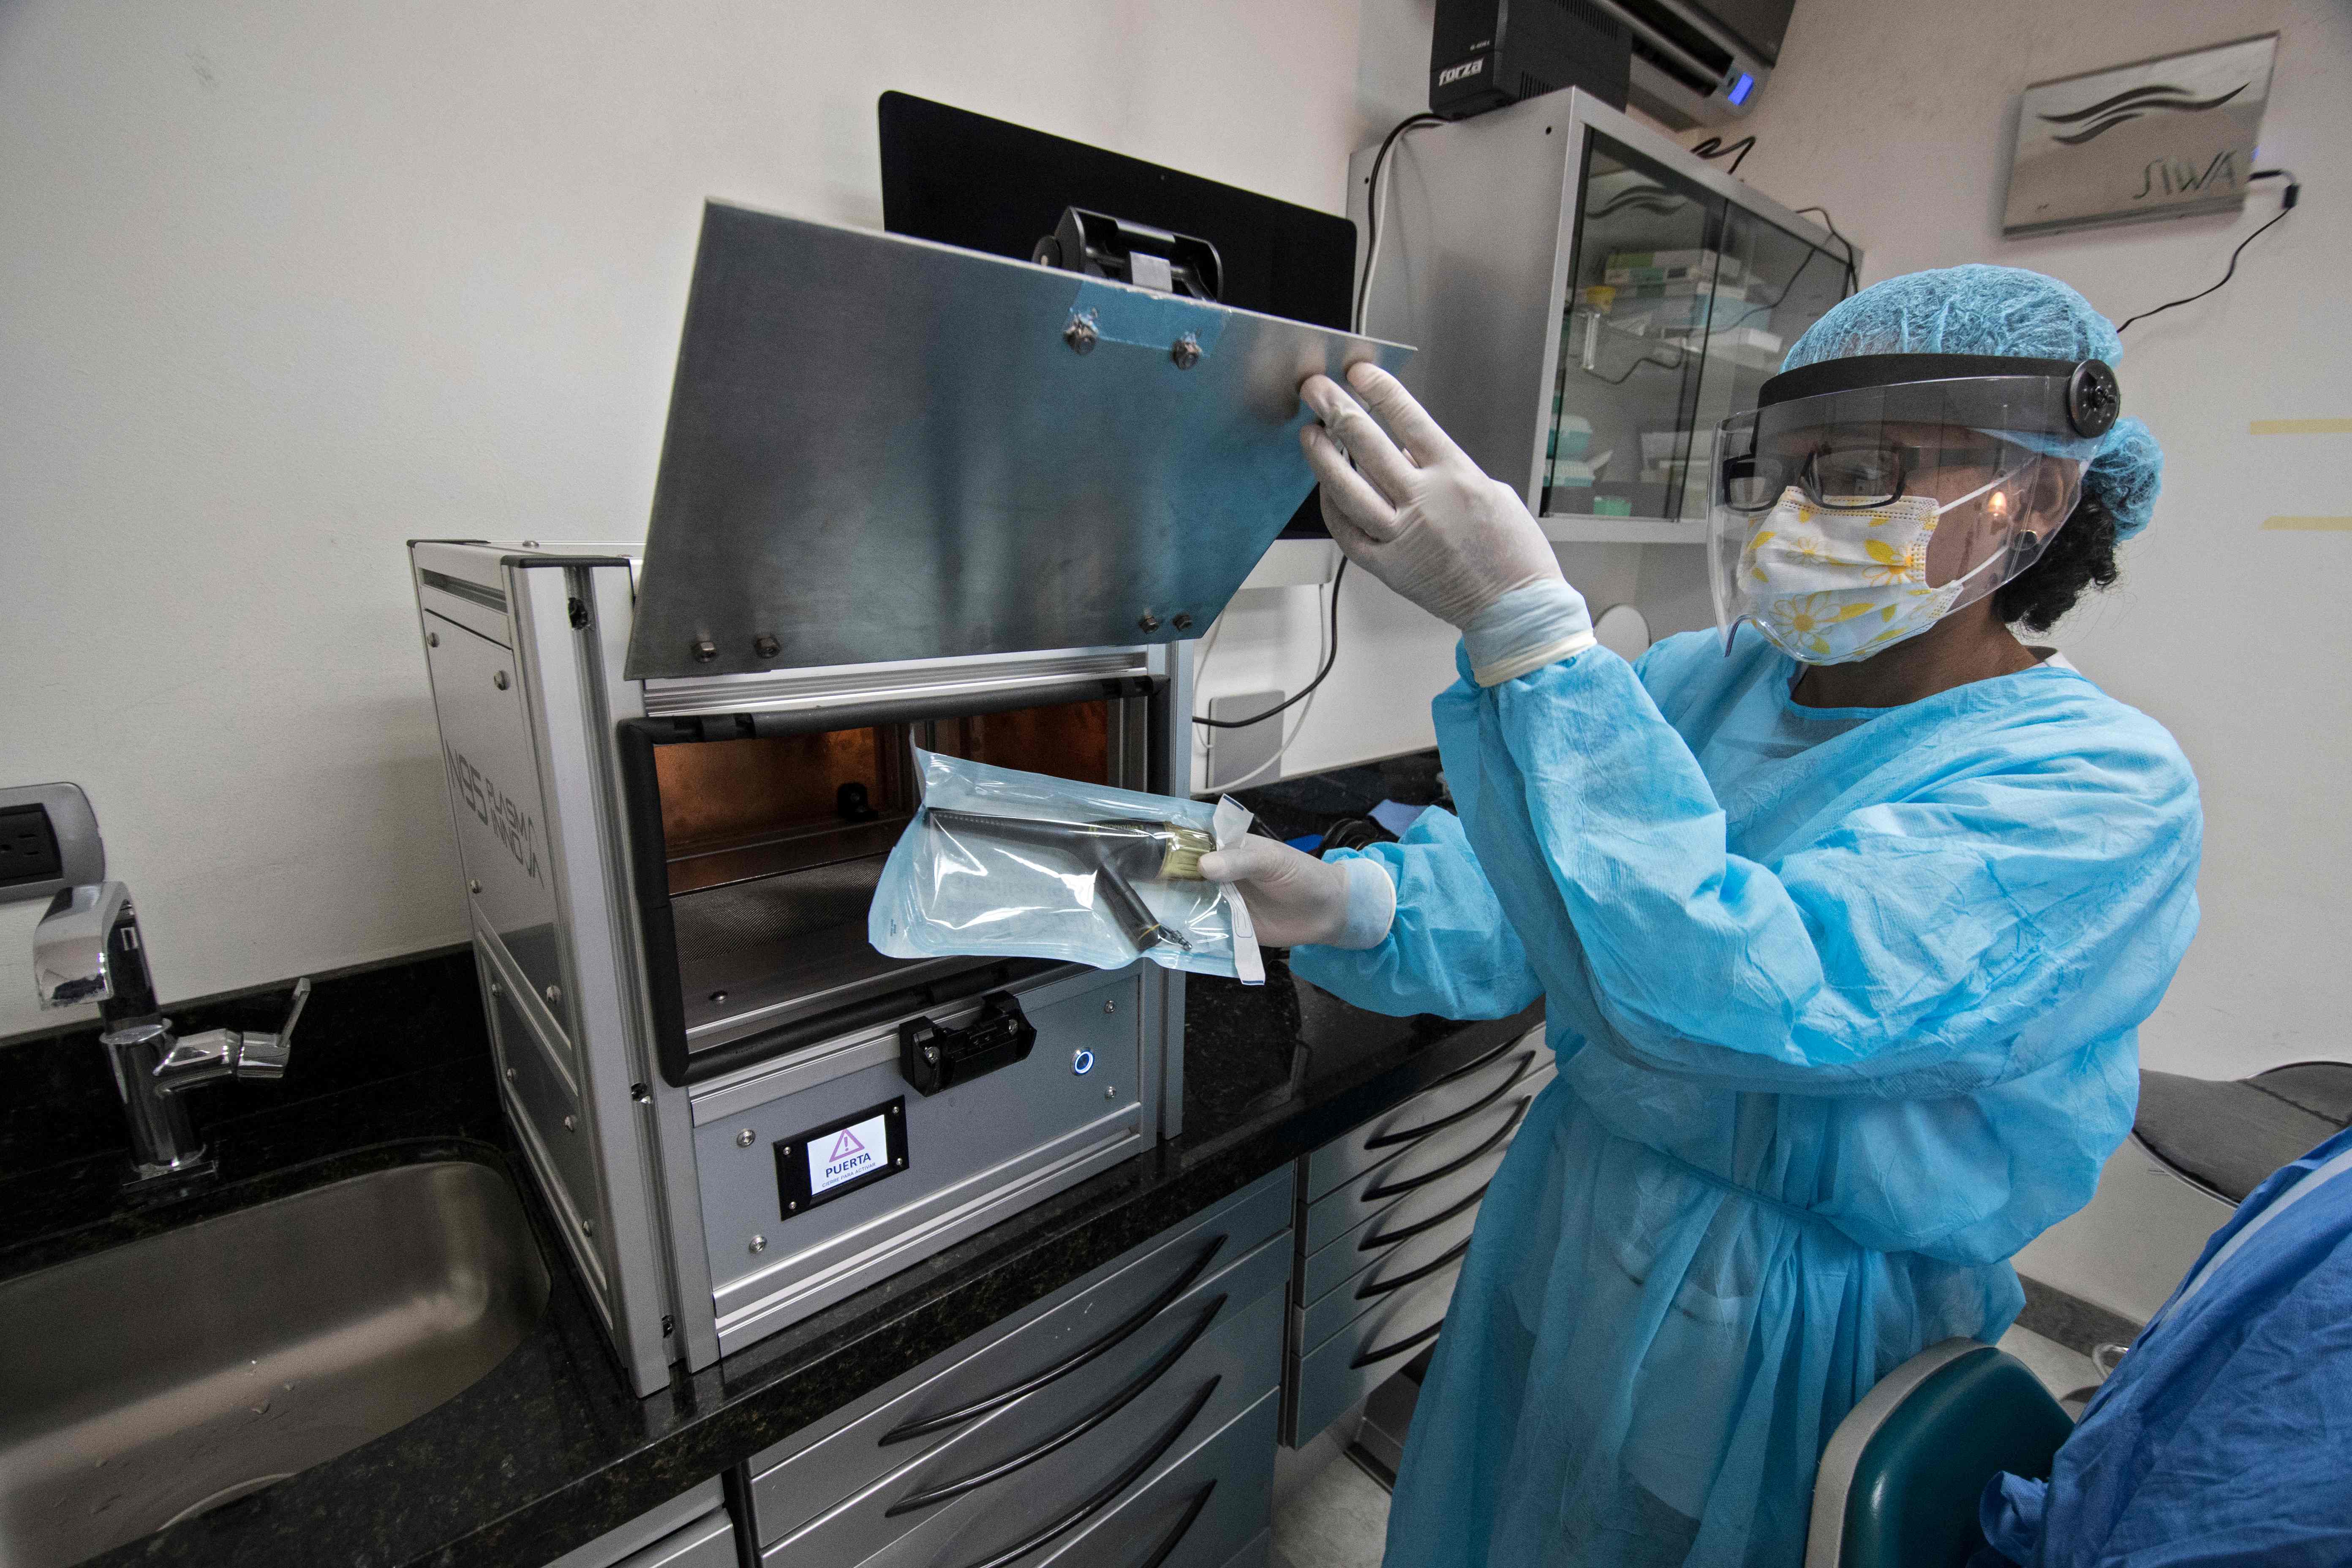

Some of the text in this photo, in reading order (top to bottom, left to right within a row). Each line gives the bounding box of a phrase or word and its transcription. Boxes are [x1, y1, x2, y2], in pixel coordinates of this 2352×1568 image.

[1439, 57, 1484, 87] forza
[2133, 150, 2238, 199] SIWA
[446, 739, 488, 826] N95
[486, 778, 538, 844] PLASMA
[490, 807, 545, 889] INNOVA
[822, 1162, 876, 1187] CIERRE PARA ACTIVAR
[826, 1152, 871, 1178] PUERTA
